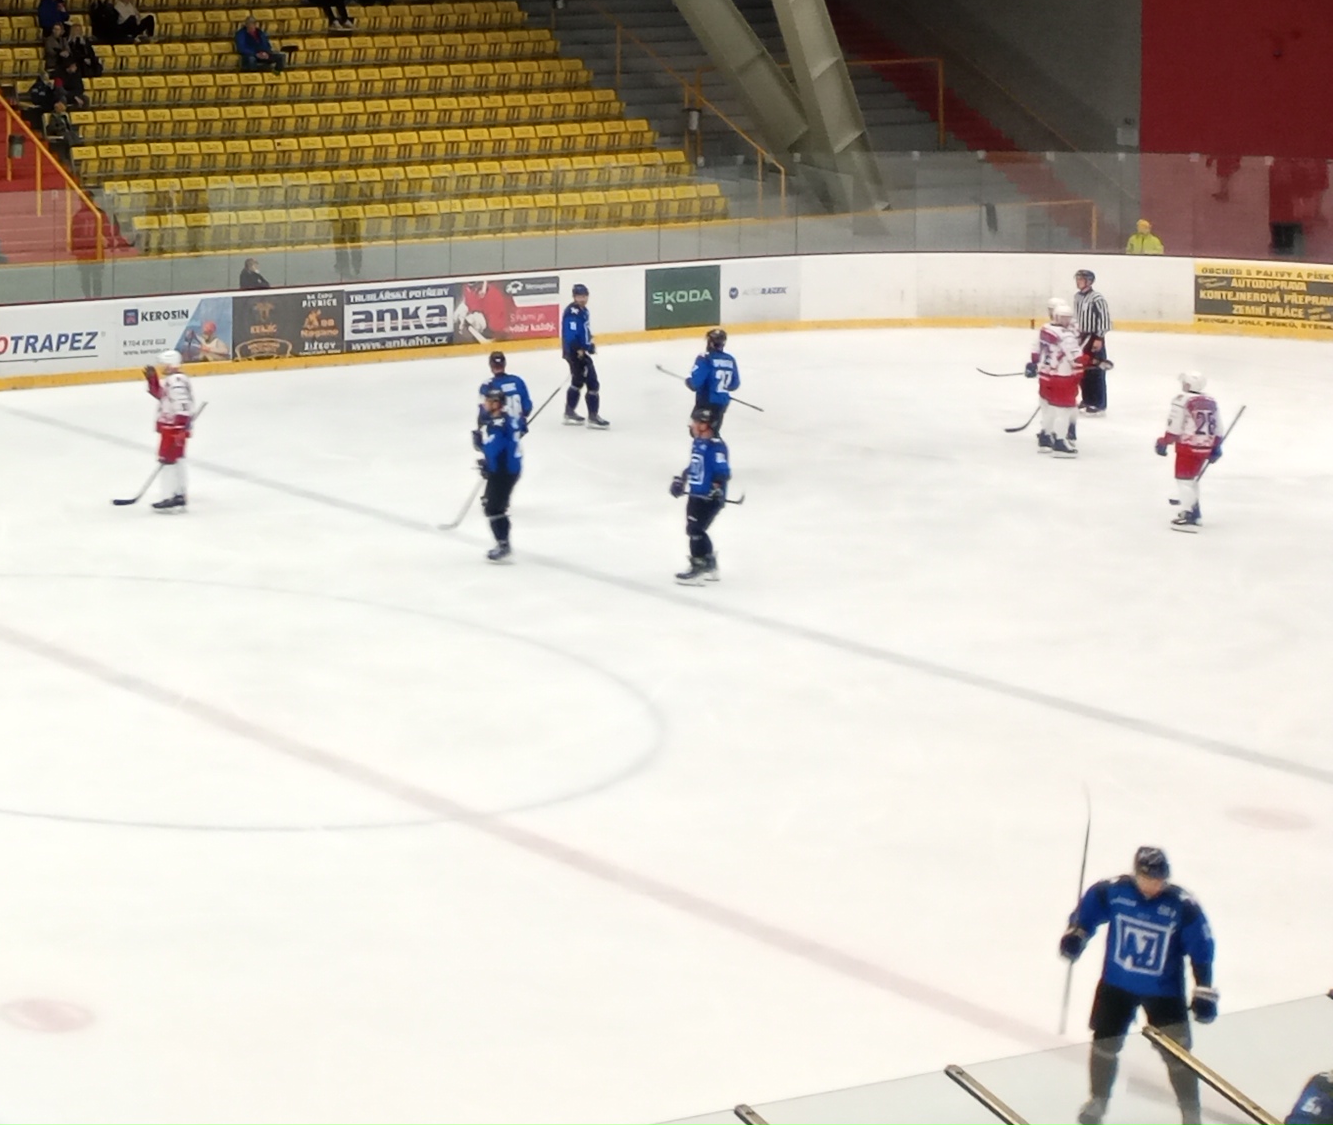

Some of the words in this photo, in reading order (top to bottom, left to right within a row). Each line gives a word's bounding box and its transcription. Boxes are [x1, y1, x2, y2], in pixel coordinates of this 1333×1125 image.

[1231, 278, 1307, 291] AUTODOPRAVA
[1199, 289, 1281, 303] KONTEJNEROVÁ
[141, 309, 189, 322] KEROSIN
[1232, 304, 1266, 316] ZEMNÍ
[1269, 305, 1305, 318] PRÁCE
[351, 304, 447, 334] anka
